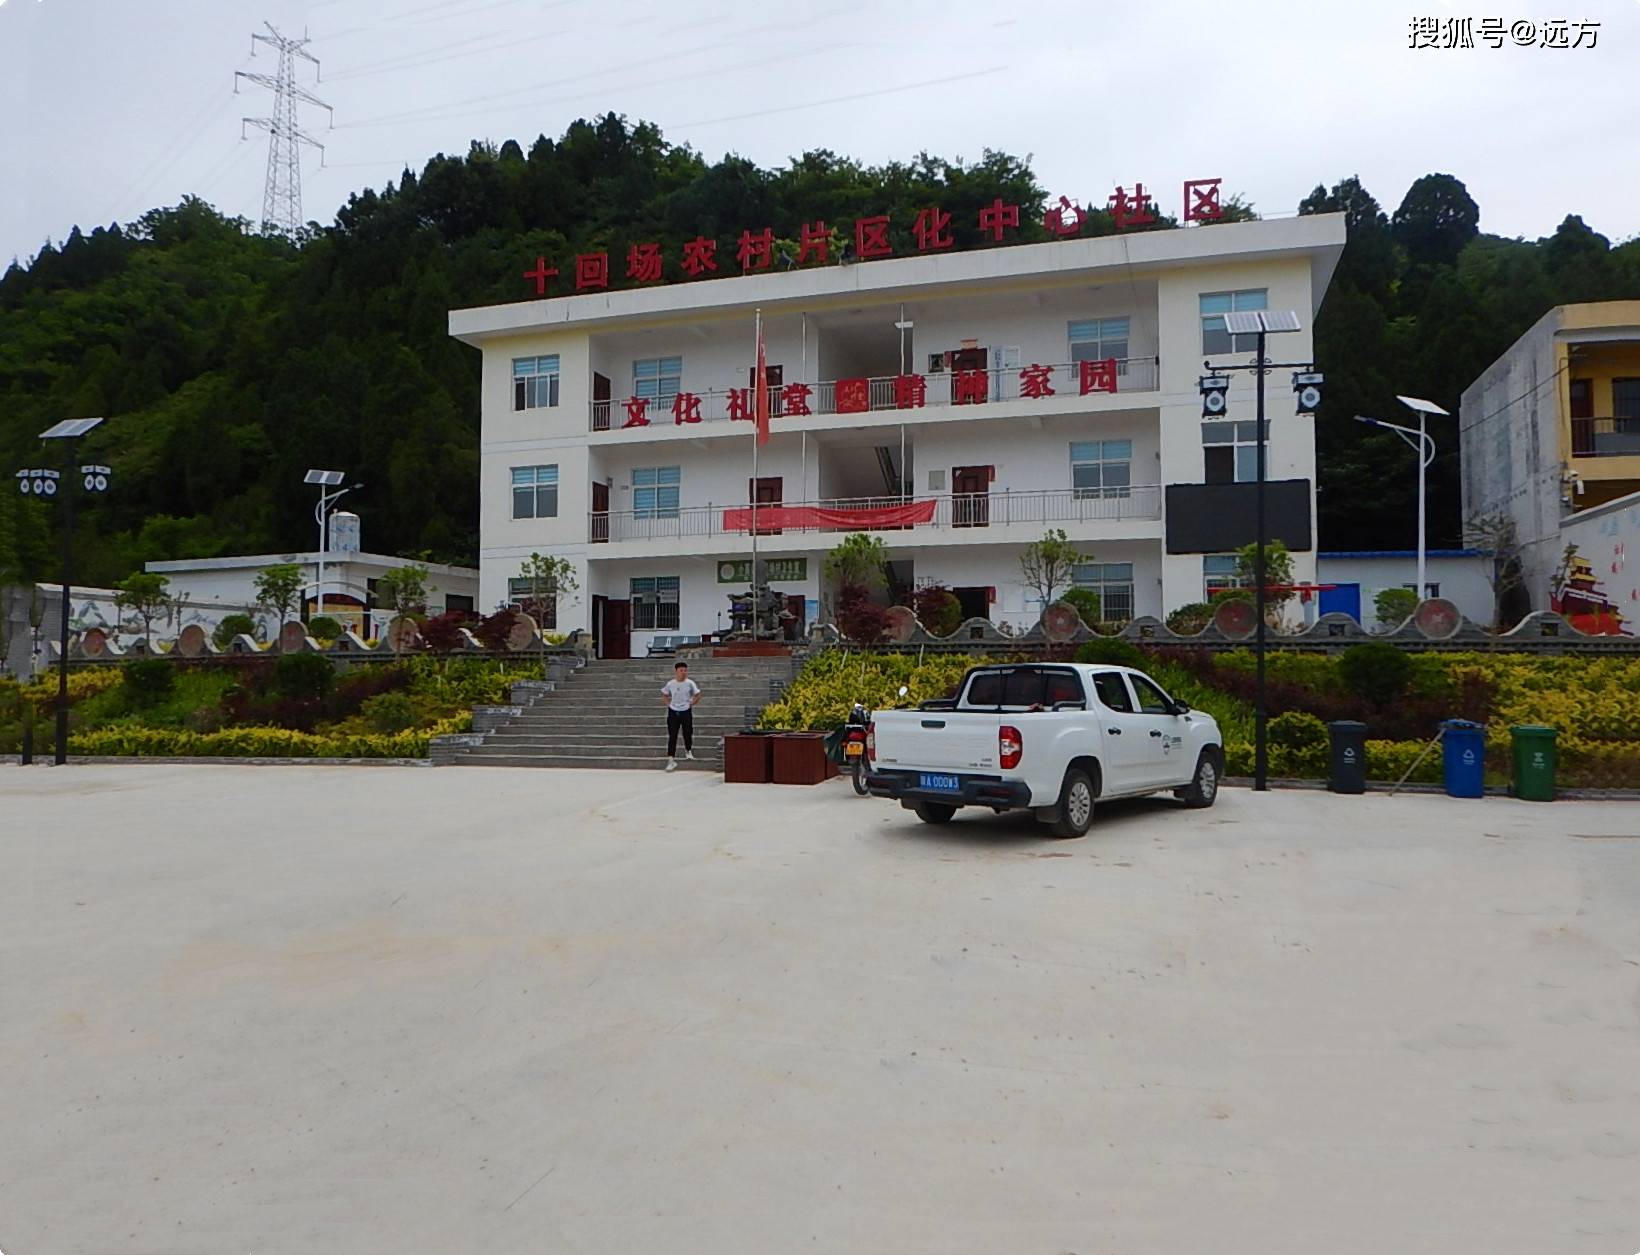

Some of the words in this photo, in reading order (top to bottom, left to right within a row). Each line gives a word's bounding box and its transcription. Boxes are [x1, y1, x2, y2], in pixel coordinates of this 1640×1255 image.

[523, 178, 1225, 295] 十回场农村片区化中心社区
[621, 382, 813, 428] 文化礼堂
